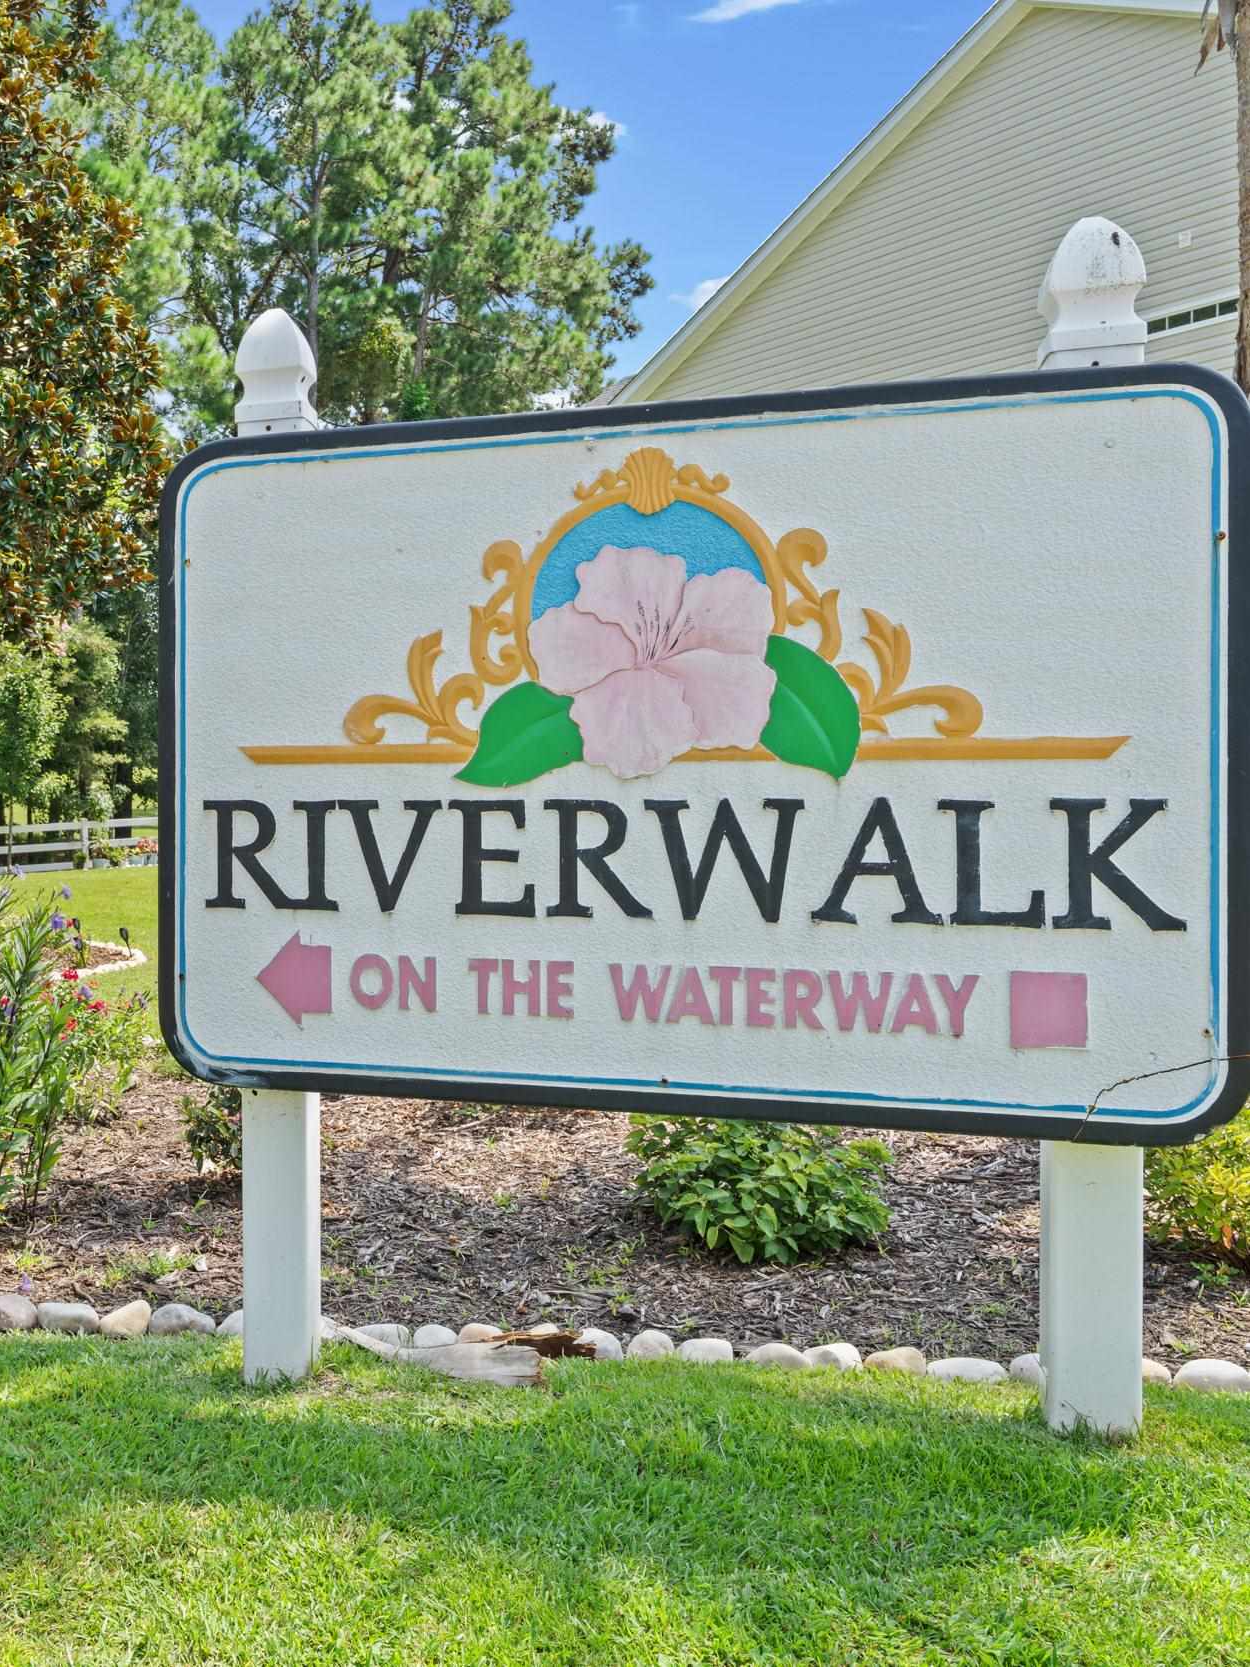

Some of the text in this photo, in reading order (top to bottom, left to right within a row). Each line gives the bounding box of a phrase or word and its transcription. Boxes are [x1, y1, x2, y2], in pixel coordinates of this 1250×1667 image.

[203, 797, 1188, 932] RIVERWALK
[350, 953, 981, 1038] ON THE WATERWAY
